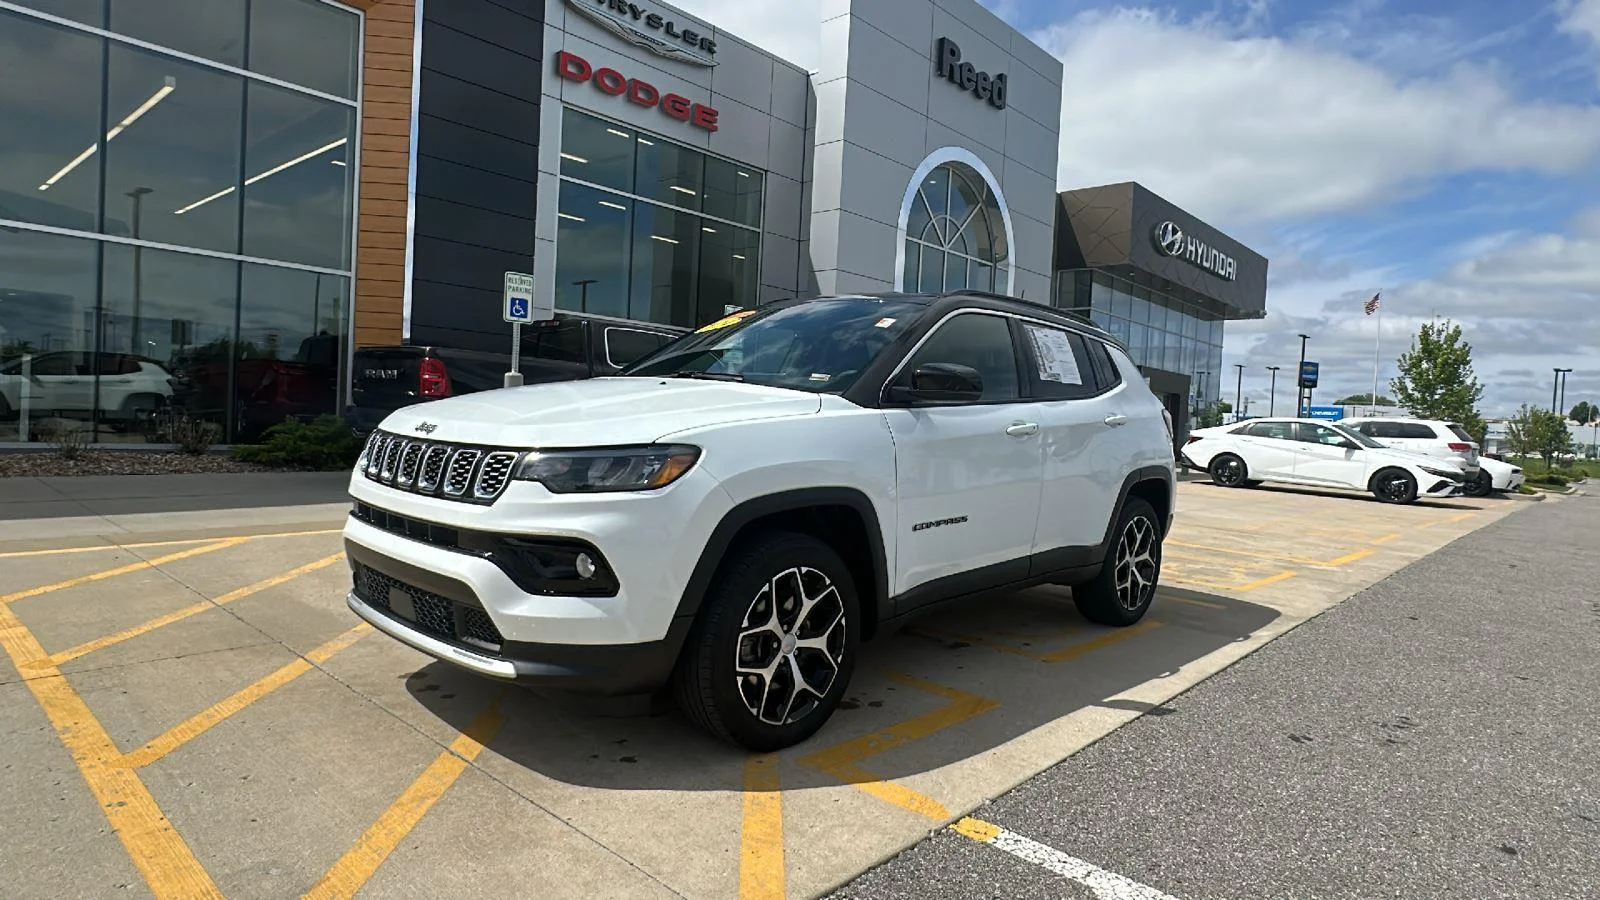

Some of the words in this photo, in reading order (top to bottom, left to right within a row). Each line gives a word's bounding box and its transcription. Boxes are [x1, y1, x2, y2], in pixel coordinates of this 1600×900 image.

[597, 0, 716, 54] RYSLER
[937, 36, 1007, 110] Reed
[556, 50, 719, 132] DODGE
[1186, 236, 1236, 280] HYUNDAI
[508, 276, 532, 287] RESERVED
[508, 285, 532, 294] PARKING
[365, 369, 398, 379] RAM
[415, 421, 438, 435] Jeep
[912, 515, 968, 531] COMPASS
